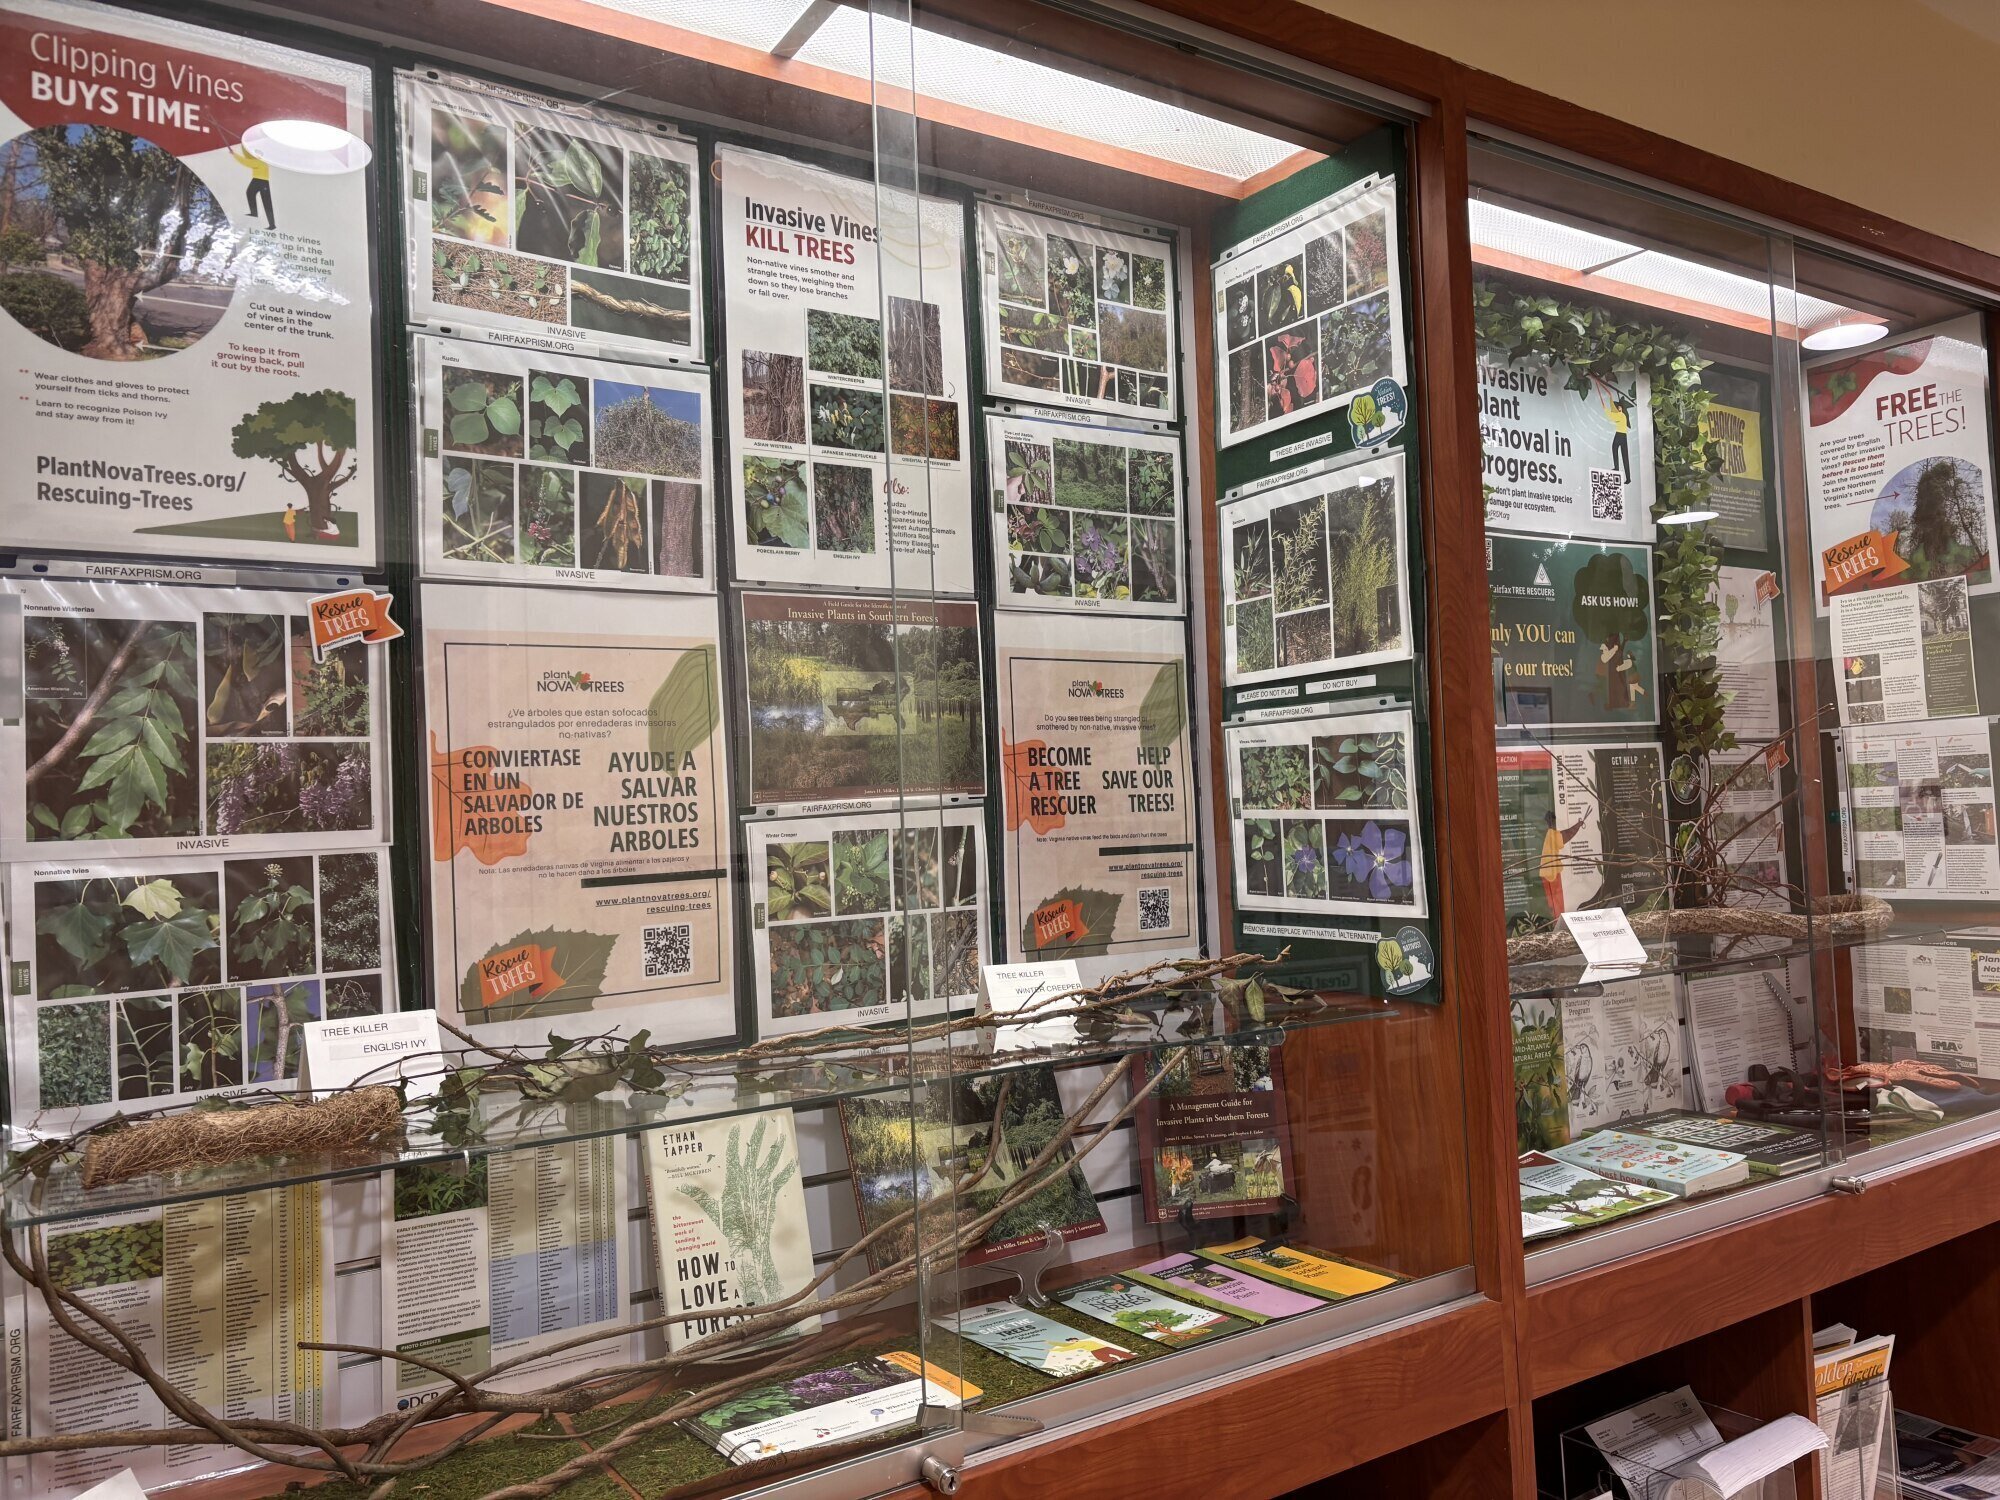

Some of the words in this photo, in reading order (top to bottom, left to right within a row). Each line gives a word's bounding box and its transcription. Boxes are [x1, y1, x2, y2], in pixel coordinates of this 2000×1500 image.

[30, 32, 156, 88] Clipping
[167, 60, 244, 103] Vines
[31, 71, 119, 114] BUYS
[127, 91, 210, 133] TIME.
[746, 197, 826, 233] Invasive
[830, 214, 882, 244] Vines
[1252, 215, 1304, 245] FAIRFAXPRISM.ORG
[746, 225, 790, 254] KILL
[794, 233, 855, 265] TREES
[747, 257, 788, 270] Non-native
[790, 264, 808, 274] vines
[810, 266, 840, 279] smother
[841, 271, 855, 281] and
[250, 302, 266, 312] Cut
[269, 306, 285, 314] out
[296, 308, 332, 319] window
[259, 314, 284, 322] vines
[286, 316, 295, 324] in
[298, 318, 313, 327] the
[244, 321, 274, 331] center
[277, 325, 288, 333] of
[290, 327, 304, 335] the
[308, 329, 334, 339] trunk.
[547, 326, 586, 340] INVASIVE
[488, 331, 574, 351] FAIRFAXPRISM.ORG
[442, 355, 459, 363] Kudzu
[1876, 384, 1937, 420] FREE
[1939, 389, 1962, 406] THE
[1034, 408, 1091, 422] FAIRFAXPRISM.ORG
[1707, 411, 1745, 444] CHOKING
[1884, 405, 1966, 447] TREES!
[1275, 448, 1291, 458] THESE
[1292, 444, 1304, 454] ARE
[1305, 436, 1332, 450] INVASIVE
[1555, 430, 1572, 457] in
[1819, 440, 1829, 448] Are
[1831, 437, 1847, 445] your
[1848, 433, 1864, 441] trees
[1820, 446, 1845, 456] covered
[1847, 443, 1855, 452] by
[1856, 437, 1881, 448] English
[36, 456, 247, 493] PlantNovaTrees.org/
[1256, 468, 1308, 488] FAIRFAXPRISM.ORG
[36, 482, 193, 512] Rescuing-Trees
[1512, 487, 1526, 499] plant
[1528, 489, 1551, 501] invasive
[1552, 494, 1573, 504] species
[1825, 534, 1872, 567] Rescue
[86, 565, 202, 580] FAIRFAXPRISM.ORG
[1828, 547, 1879, 583] TREES
[555, 570, 595, 579] INVASIVE
[1512, 587, 1526, 595] TREE
[1526, 587, 1555, 596] RESCUERS
[24, 604, 62, 612] Nonnative
[316, 596, 364, 620] Rescue
[1581, 596, 1598, 606] ASK
[1600, 596, 1611, 607] US
[1613, 597, 1638, 608] HOW!
[320, 608, 370, 636] TREES
[788, 608, 824, 619] Invasive
[827, 609, 855, 620] Plants
[857, 611, 866, 620] in
[1515, 624, 1551, 643] YOU
[1555, 629, 1575, 644] can
[543, 670, 570, 681] plant
[1516, 661, 1537, 676] our
[1542, 659, 1573, 676] trees!
[537, 680, 574, 692] NOVA
[590, 681, 625, 692] TREES
[1322, 682, 1330, 690] DO
[1331, 680, 1342, 689] NOT
[1344, 679, 1357, 687] BUY
[1260, 707, 1313, 718] FAIRFAXPRISM.ORG
[463, 749, 581, 768] CONVIERTASE
[608, 751, 676, 773] AYUDE
[682, 751, 696, 770] A
[1028, 747, 1092, 766] BECOME
[1137, 747, 1171, 766] HELP
[1612, 756, 1622, 765] GET
[1624, 756, 1638, 764] HELP
[464, 773, 486, 790] EN
[494, 772, 520, 790] UN
[621, 776, 697, 799] SALVAR
[1029, 772, 1040, 791] A
[1044, 772, 1080, 790] TREE
[1102, 771, 1137, 790] SAVE
[1142, 770, 1174, 788] OUR
[464, 794, 556, 814] SALVADOR
[563, 792, 584, 809] DE
[802, 801, 872, 813] FAIRFAXPRISM.ORG
[1031, 795, 1096, 816] RESCUER
[1128, 793, 1175, 812] TREES!
[594, 802, 698, 827] NUESTROS
[464, 816, 543, 836] ARBOLES
[176, 838, 229, 850] INVASIVE
[610, 828, 699, 852] ARBOLES
[34, 869, 70, 877] Nonnative
[596, 890, 711, 906] www.plantnovatrees.org/
[646, 902, 712, 914] rescuing-trees
[1036, 904, 1066, 925] Rescue
[1039, 914, 1071, 940] TREES
[1570, 915, 1585, 923] TREE
[1244, 924, 1266, 933] REMOVE
[1267, 926, 1276, 934] AND
[1277, 927, 1301, 935] REPLACE
[1316, 930, 1336, 938] NATIVE
[1340, 932, 1378, 941] ALTERNATIVE
[1592, 928, 1626, 938] BITTERSWEET
[483, 949, 530, 978] Rescue
[487, 962, 536, 995] TREES
[1018, 970, 1044, 978] KILLER
[1015, 985, 1045, 994] WINTER
[1047, 983, 1082, 992] CREEPER
[857, 1007, 889, 1018] INVASIVE
[1569, 1008, 1590, 1016] Program
[322, 1025, 350, 1038] TREE
[353, 1022, 389, 1035] KILLER
[1526, 1034, 1550, 1042] INVADERS
[363, 1041, 406, 1054] ENGLISH
[409, 1038, 427, 1050] IVY
[1534, 1051, 1551, 1059] AREAS
[1177, 1102, 1219, 1111] Management
[1221, 1100, 1241, 1108] Guide
[1242, 1098, 1253, 1106] for
[1156, 1118, 1183, 1126] Invasive
[1184, 1116, 1205, 1124] Plants
[1214, 1113, 1245, 1122] Southern
[1246, 1111, 1269, 1120] Forests
[663, 1131, 695, 1145] ETHAN
[664, 1142, 703, 1158] TAPPER
[1598, 1170, 1618, 1181] best
[1619, 1173, 1642, 1185] hope
[678, 1252, 720, 1281] HOW
[724, 1261, 735, 1272] TO
[681, 1280, 728, 1310] LOVE
[734, 1289, 740, 1299] A
[1091, 1293, 1141, 1309] NOVA
[1099, 1297, 1152, 1313] TREES
[978, 1323, 1009, 1335] SAVE
[1011, 1319, 1035, 1329] THE
[996, 1325, 1037, 1337] TREES
[11, 1328, 21, 1438] FAIRFAXPRISM.ORG
[1843, 1363, 1883, 1386] Gazette
